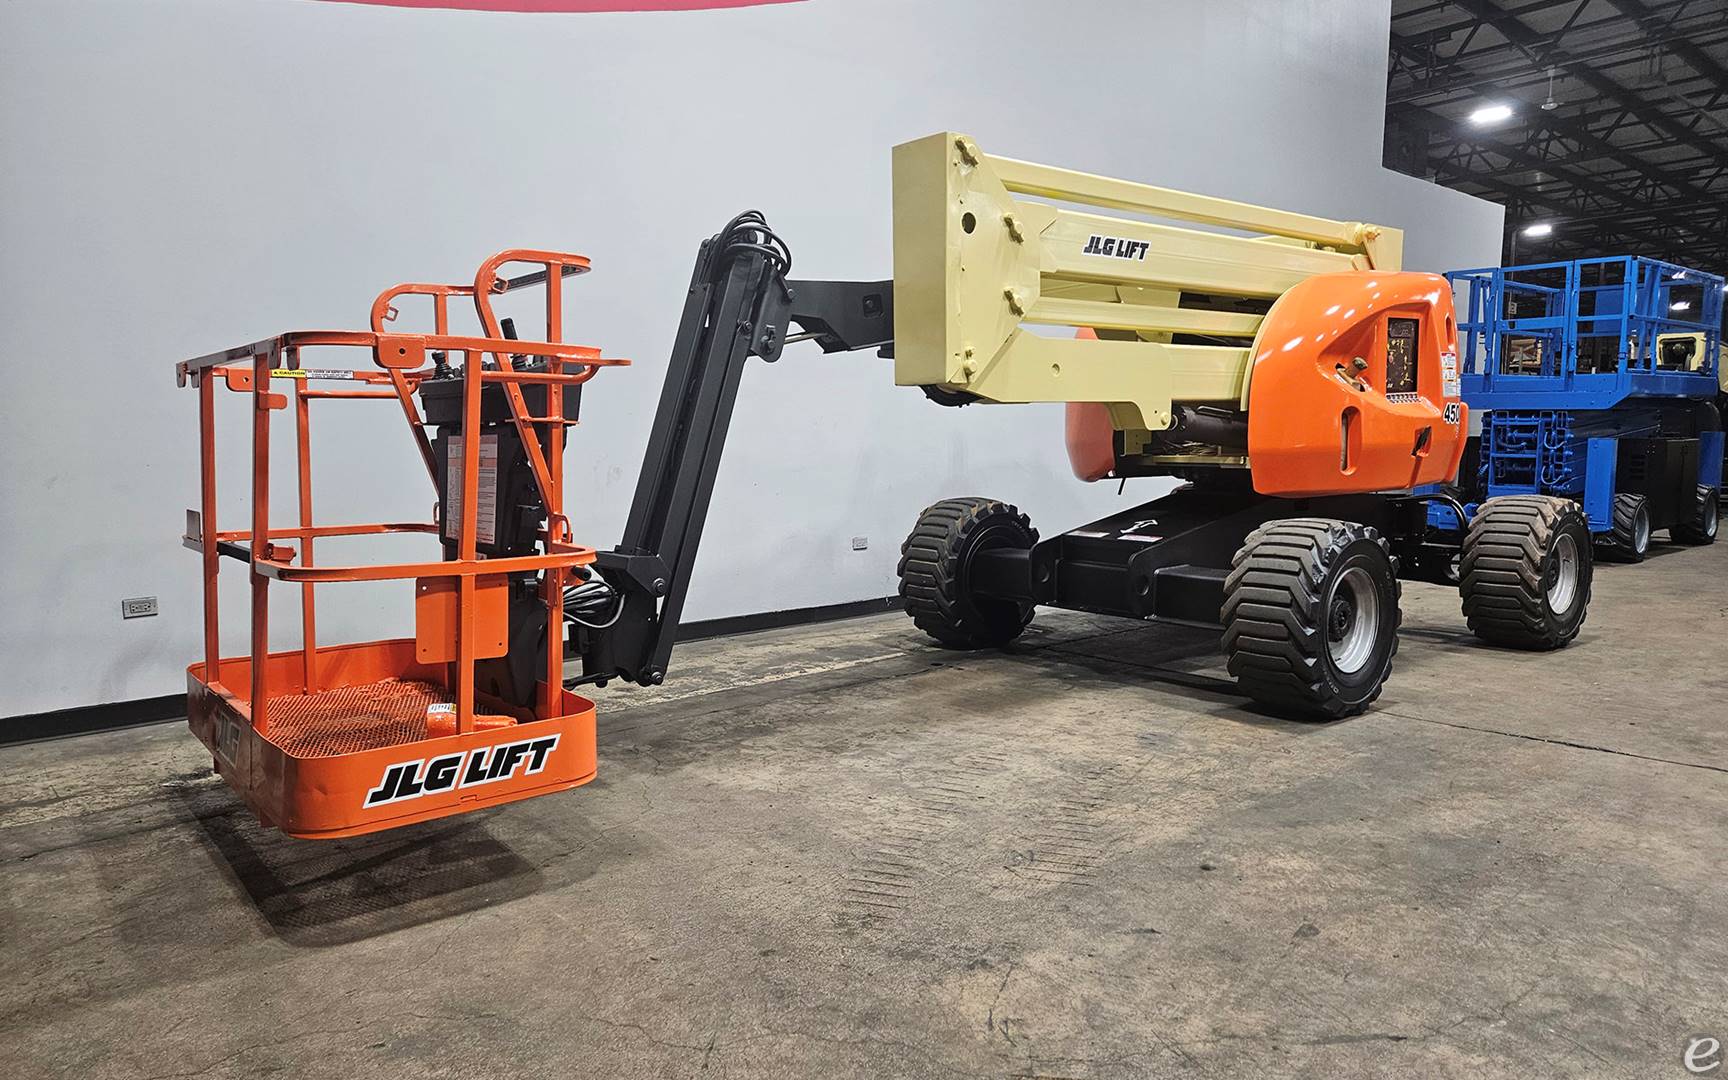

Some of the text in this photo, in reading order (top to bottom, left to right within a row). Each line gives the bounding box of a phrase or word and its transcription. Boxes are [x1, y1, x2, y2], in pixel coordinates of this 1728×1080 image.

[1083, 236, 1150, 260] JLG LIFT
[367, 737, 558, 804] JLG LIFT
